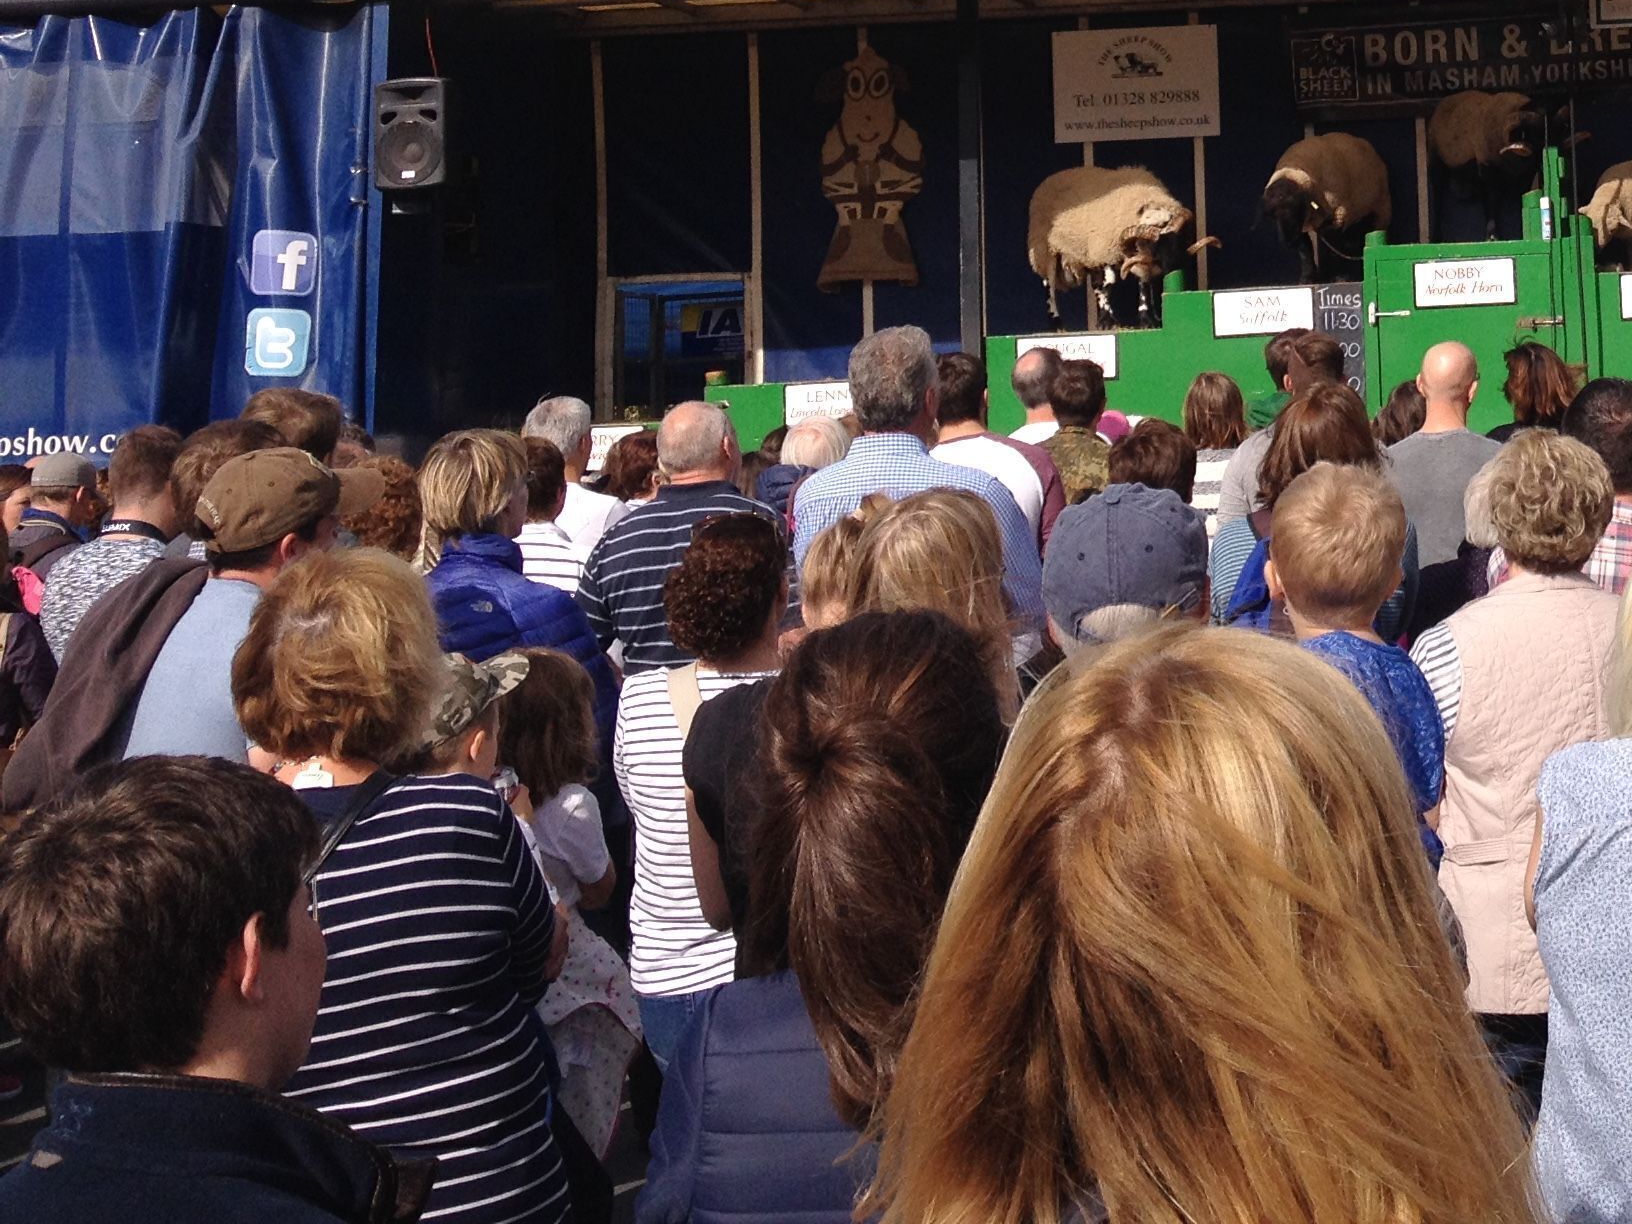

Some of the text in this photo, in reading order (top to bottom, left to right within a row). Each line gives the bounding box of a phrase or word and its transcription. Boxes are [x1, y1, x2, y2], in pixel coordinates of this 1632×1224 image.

[1364, 27, 1479, 67] BORN
[1501, 24, 1528, 59] &
[1299, 66, 1352, 79] BLACK
[1299, 78, 1353, 93] SHEEP
[1366, 73, 1393, 95] IN
[1103, 92, 1146, 105] 01328
[1150, 90, 1200, 104] 829888
[1064, 114, 1211, 131] www.thesheepshow.co.uk
[1434, 265, 1483, 280] NOBBY
[1425, 281, 1503, 296] Norfolk Horn
[1244, 295, 1281, 307] SAM
[1317, 287, 1362, 308] Times
[1239, 310, 1289, 326] Suffolk
[1034, 343, 1095, 354] UGAL
[807, 388, 848, 403] LENN
[0, 427, 117, 456] pshow.c
